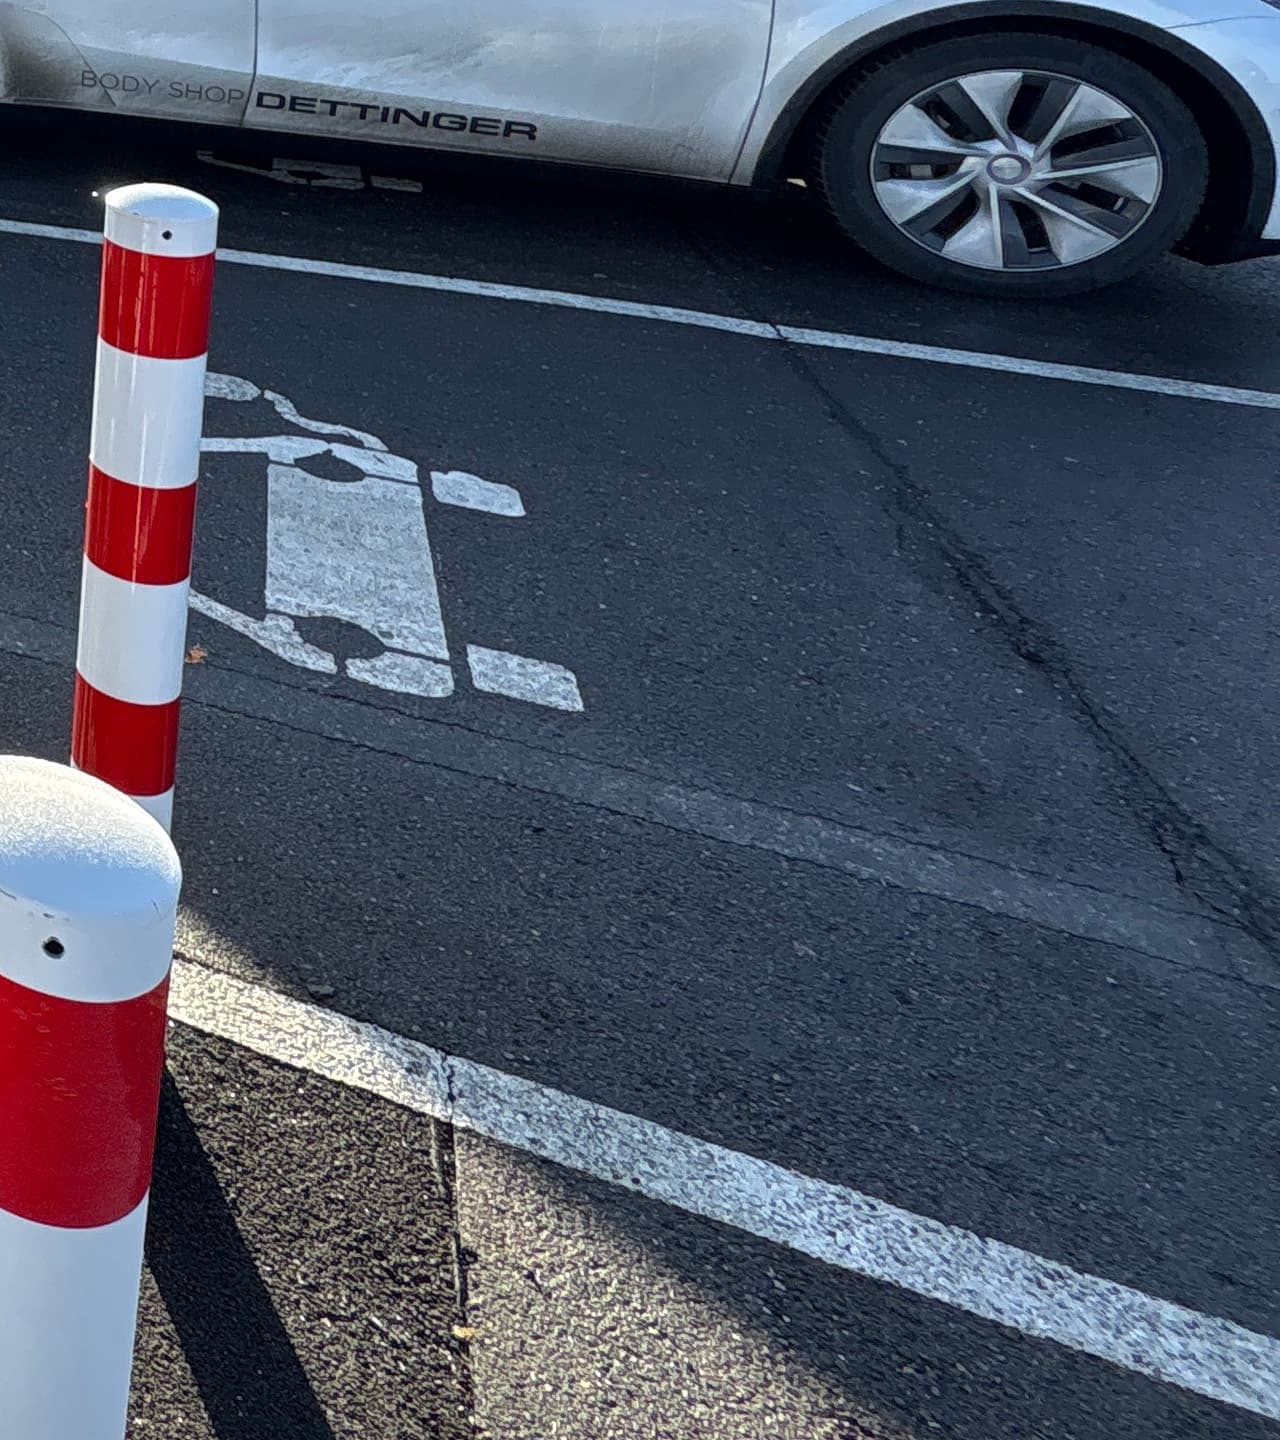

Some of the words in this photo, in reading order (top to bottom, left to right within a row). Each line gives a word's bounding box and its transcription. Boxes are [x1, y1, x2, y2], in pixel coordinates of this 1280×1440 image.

[81, 69, 161, 94] BODY
[169, 82, 245, 105] SHOP
[256, 91, 537, 141] DETTINGER
